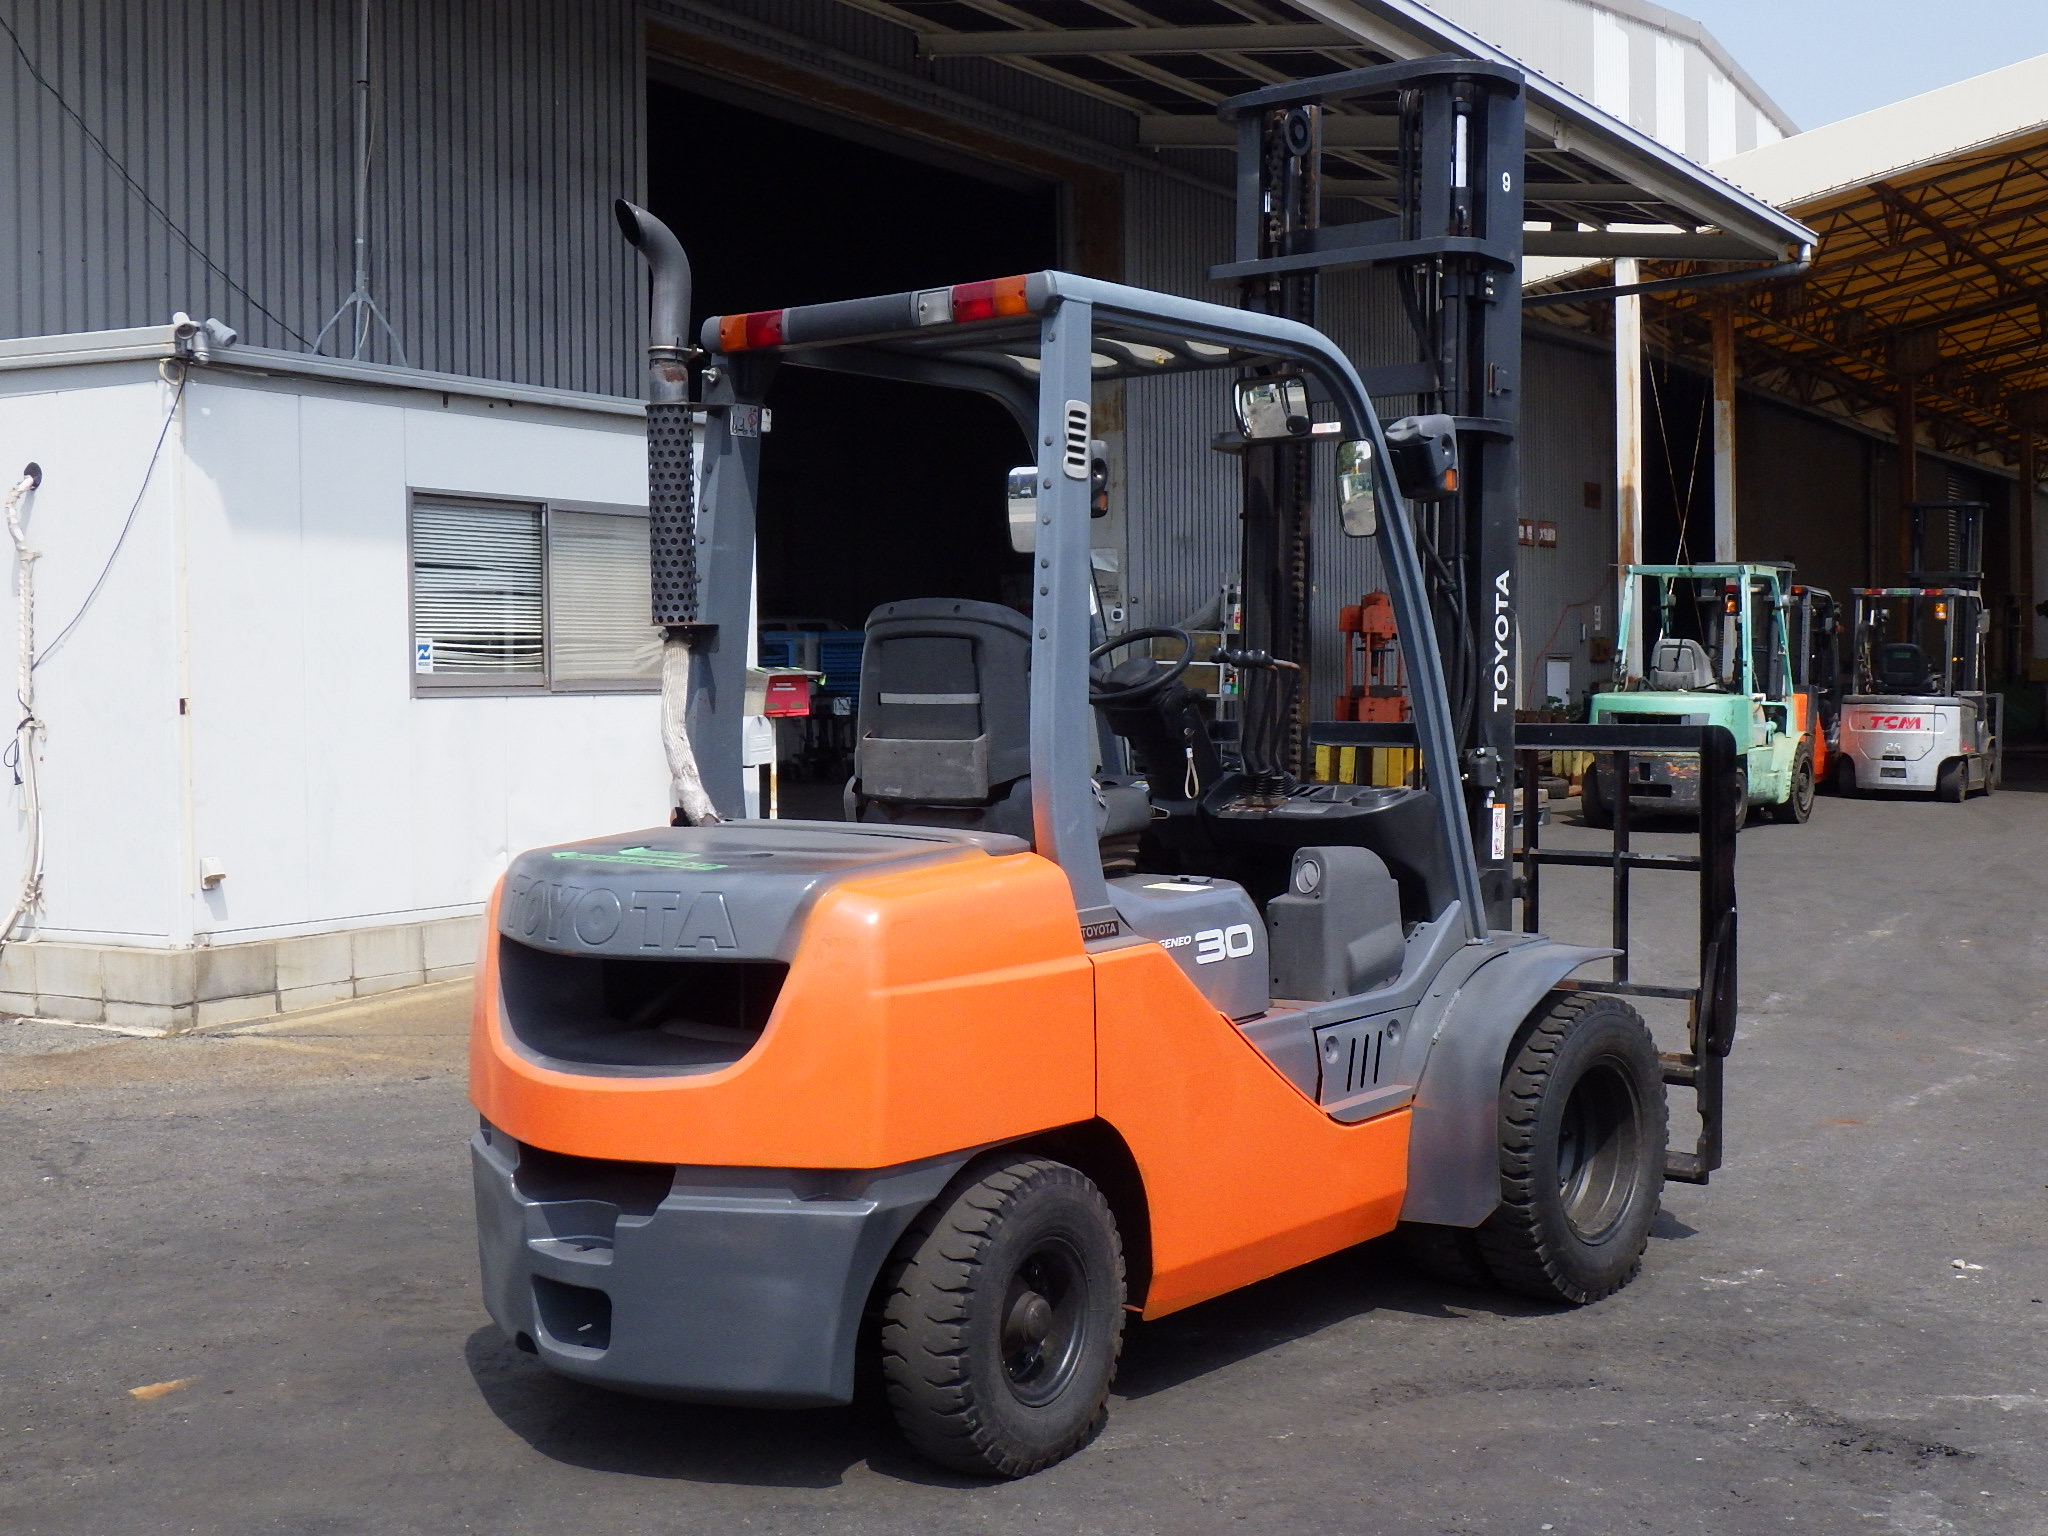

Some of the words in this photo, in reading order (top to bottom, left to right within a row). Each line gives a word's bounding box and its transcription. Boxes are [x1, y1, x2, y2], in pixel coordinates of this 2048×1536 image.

[1502, 171, 1511, 192] 9
[1494, 570, 1510, 713] TOYOTA
[1870, 716, 1922, 729] TCM
[507, 874, 740, 950] TOYOTA
[1081, 922, 1117, 939] TOYOTA
[1195, 923, 1254, 965] 30
